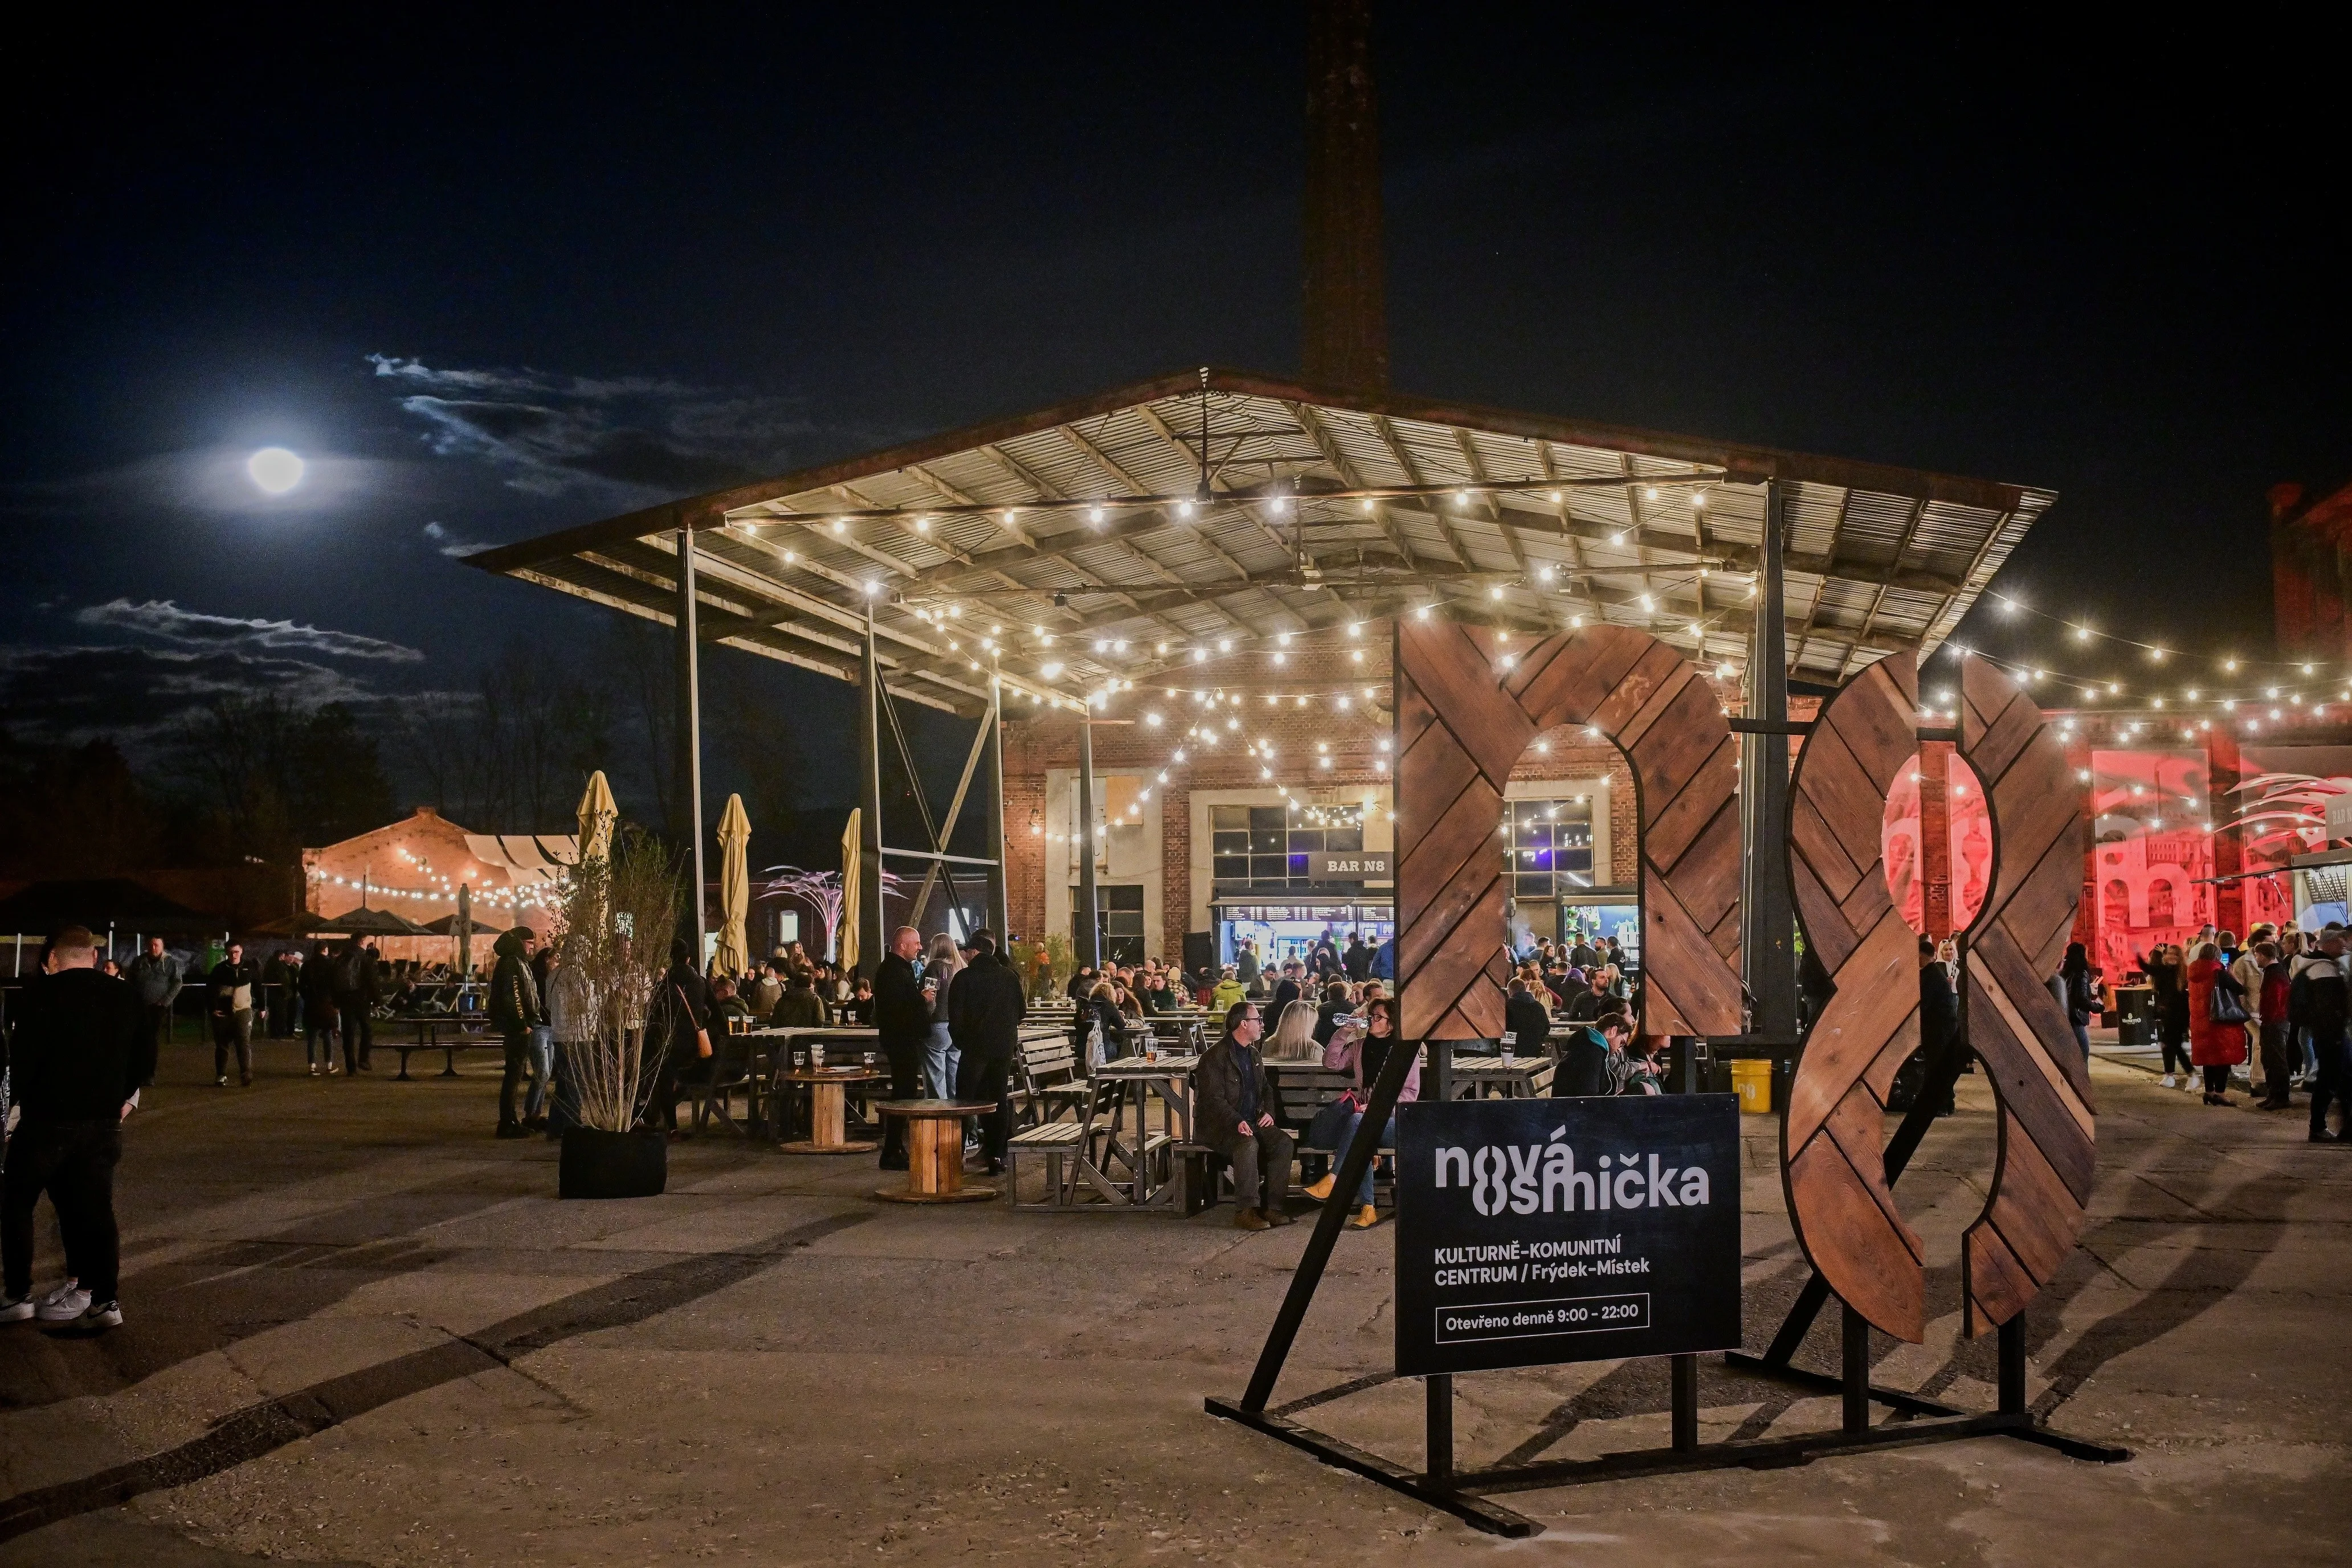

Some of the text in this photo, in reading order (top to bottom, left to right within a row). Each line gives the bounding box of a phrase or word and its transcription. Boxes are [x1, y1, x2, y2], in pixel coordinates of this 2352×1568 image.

[2332, 809, 2346, 825] BAR
[1327, 860, 1385, 872] BAR N8
[1435, 1125, 1574, 1188] nová
[1435, 1233, 1622, 1264] KULTURNĚ-KOMUNITNÍ
[1435, 1257, 1650, 1286] CENTRUM / Frýdek-Místek
[1446, 1312, 1510, 1332] Otevřeno
[1512, 1309, 1554, 1326] denně
[1557, 1308, 1588, 1322] 9:00
[1602, 1304, 1639, 1319] 22:00
